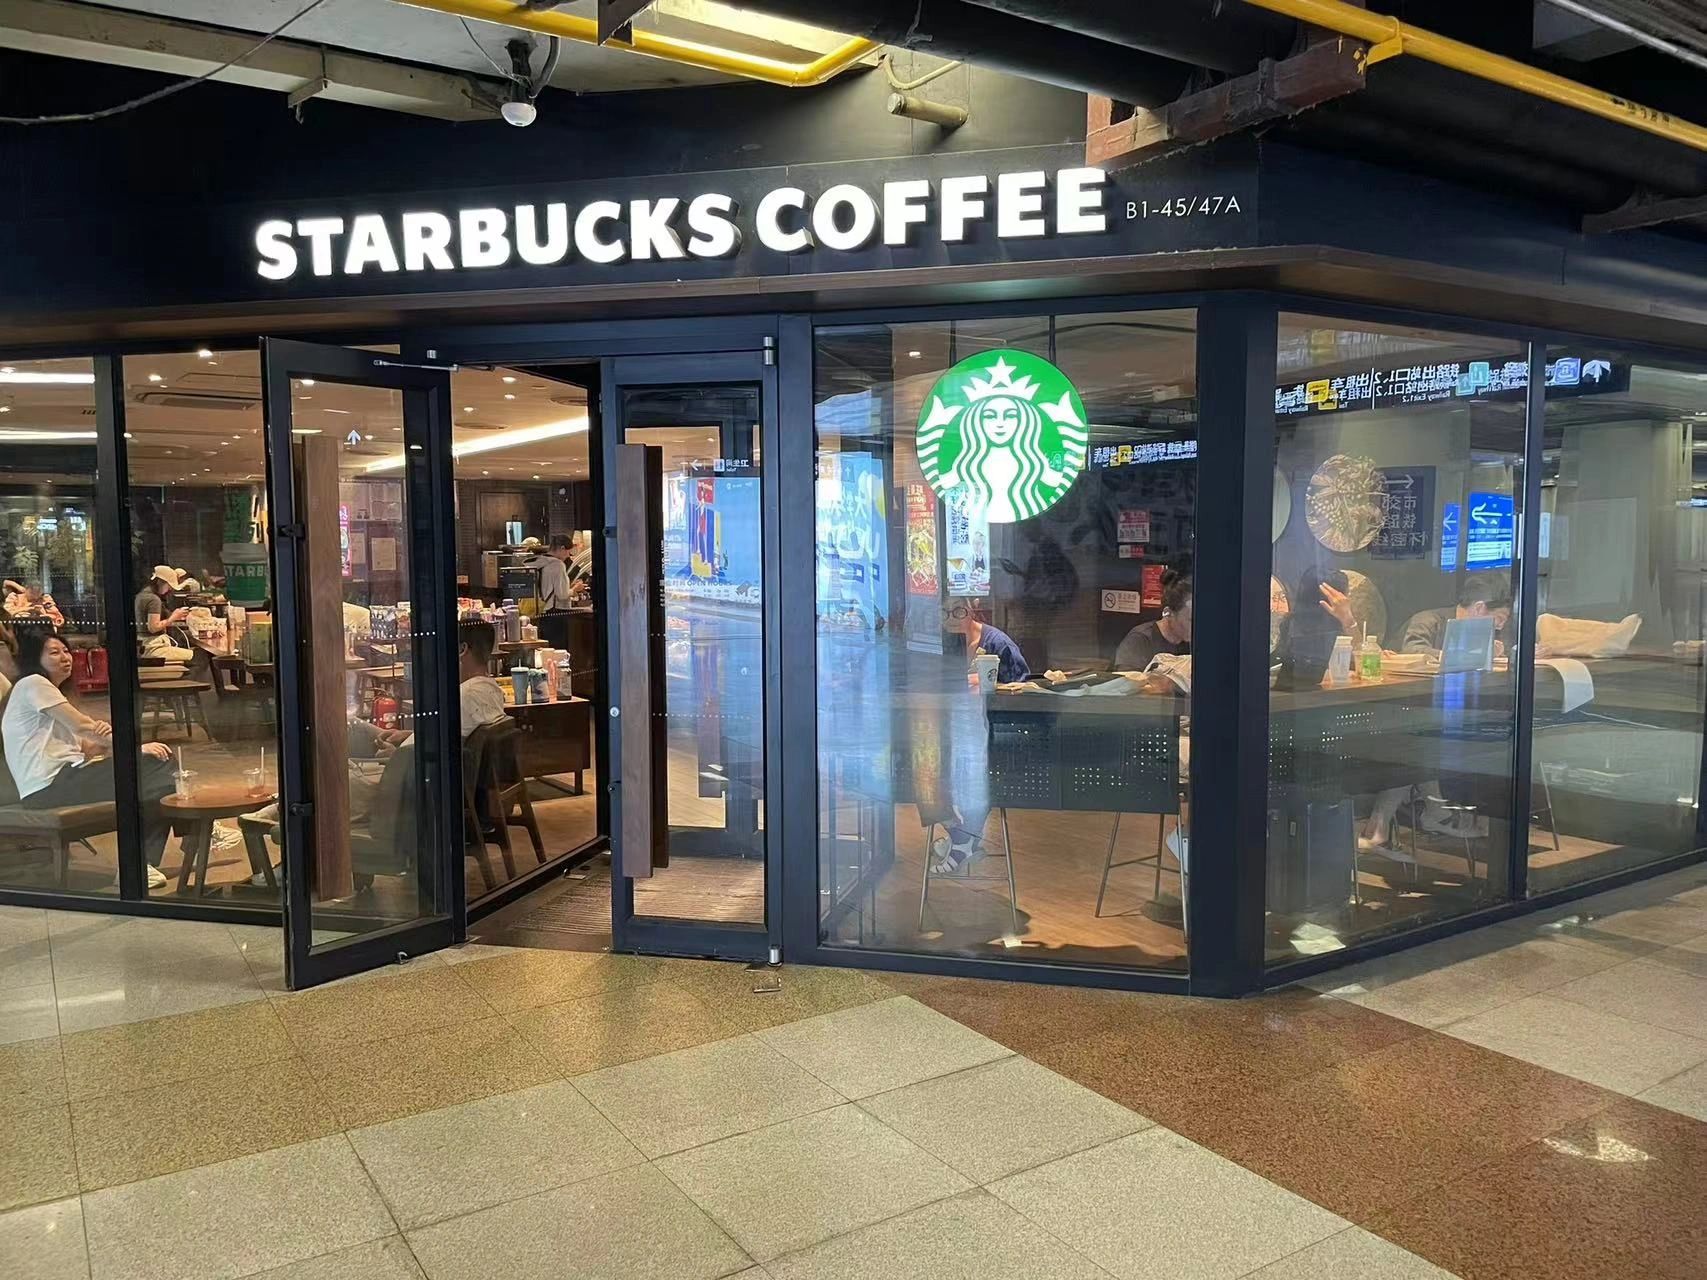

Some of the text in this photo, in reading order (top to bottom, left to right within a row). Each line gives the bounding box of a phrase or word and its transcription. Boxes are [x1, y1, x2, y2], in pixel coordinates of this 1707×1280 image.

[255, 168, 1108, 281] STARBUCKS COFFEE
[1125, 195, 1242, 221] B1-45/47A
